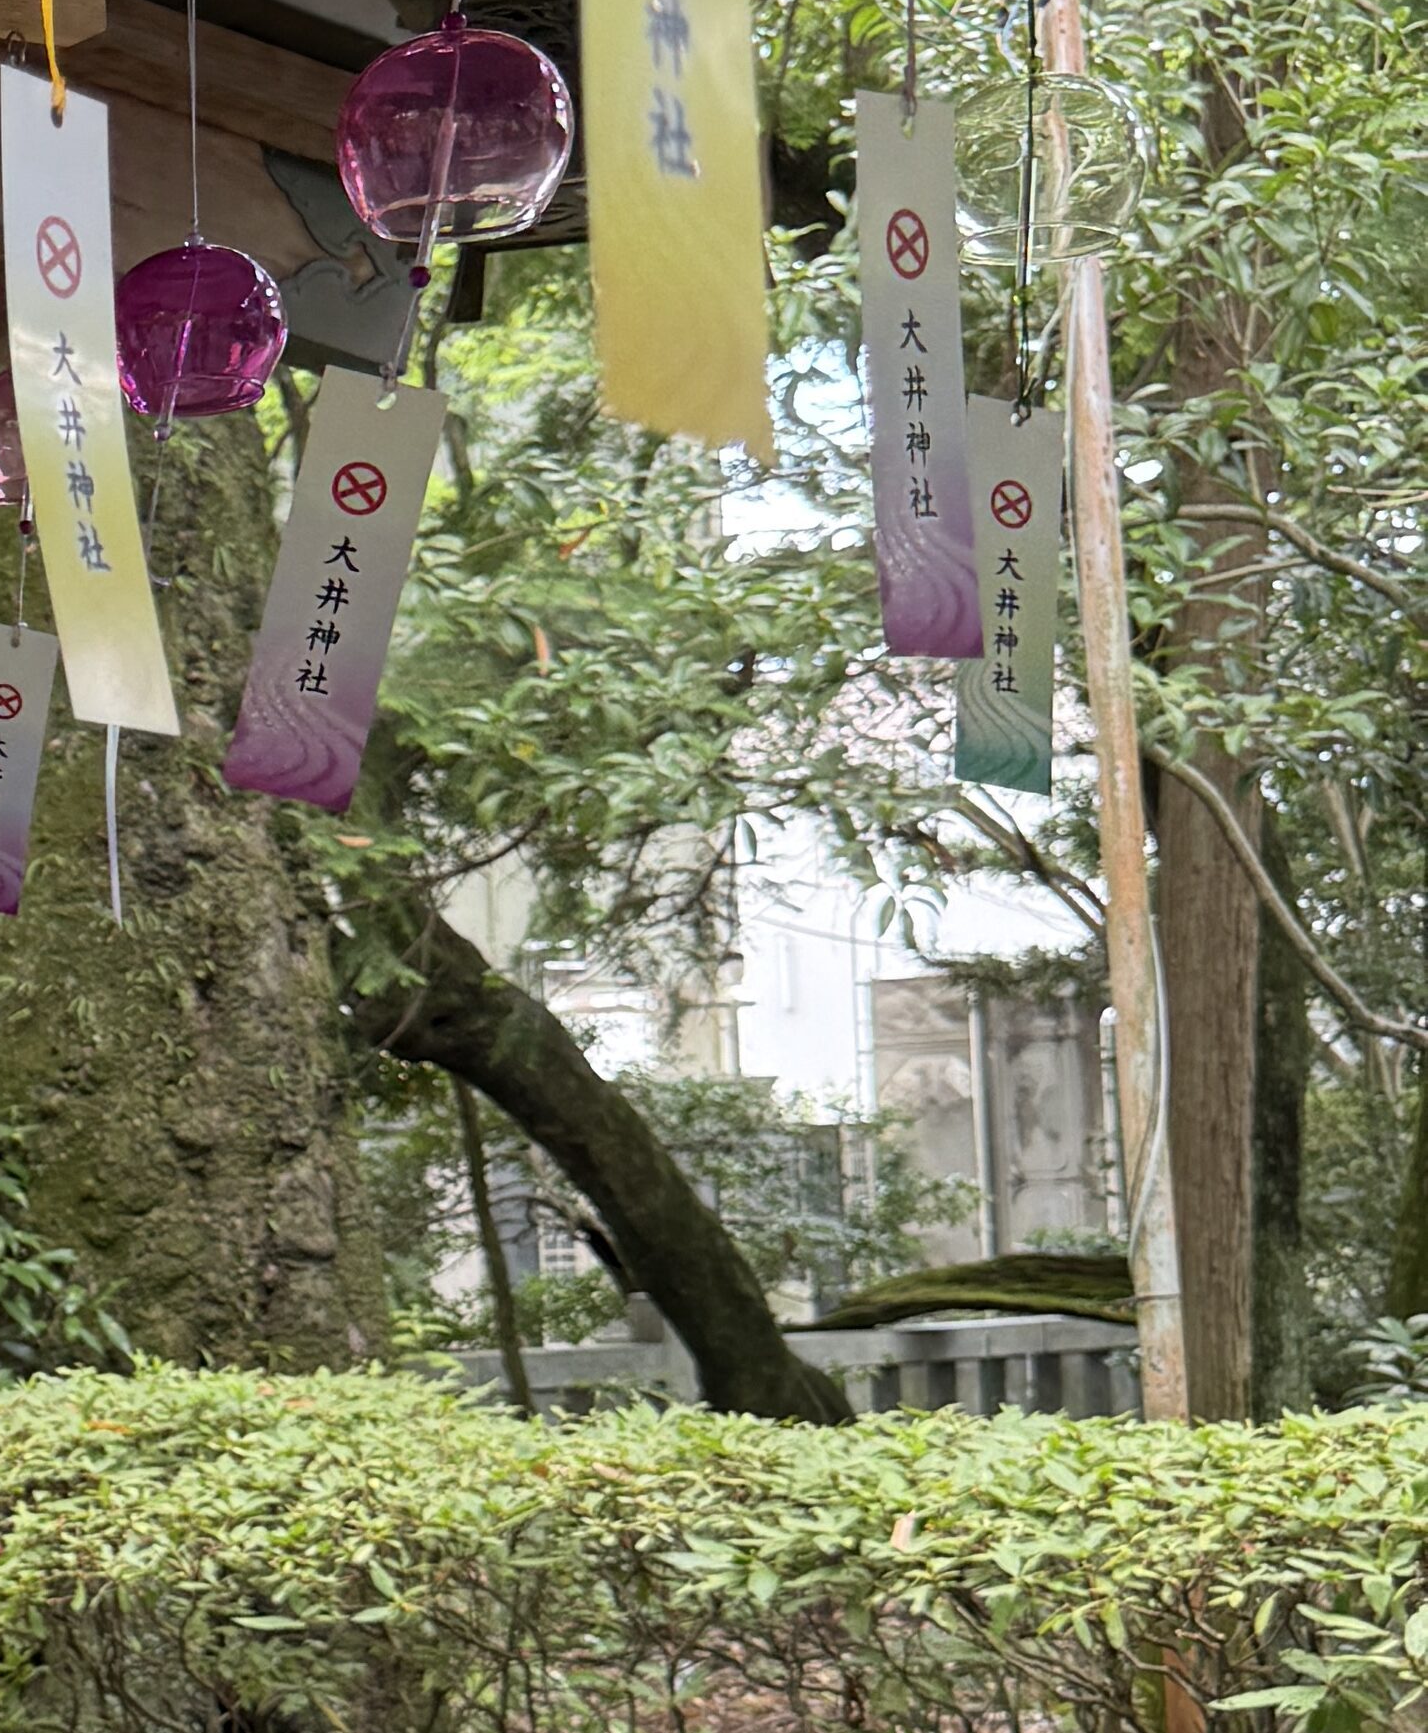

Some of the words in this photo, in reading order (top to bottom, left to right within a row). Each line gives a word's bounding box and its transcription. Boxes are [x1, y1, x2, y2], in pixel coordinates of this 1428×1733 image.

[50, 332, 112, 574] 大井神社
[900, 310, 938, 519] 大井神社
[293, 537, 362, 697] 大井神社
[992, 548, 1023, 694] 大井神社
